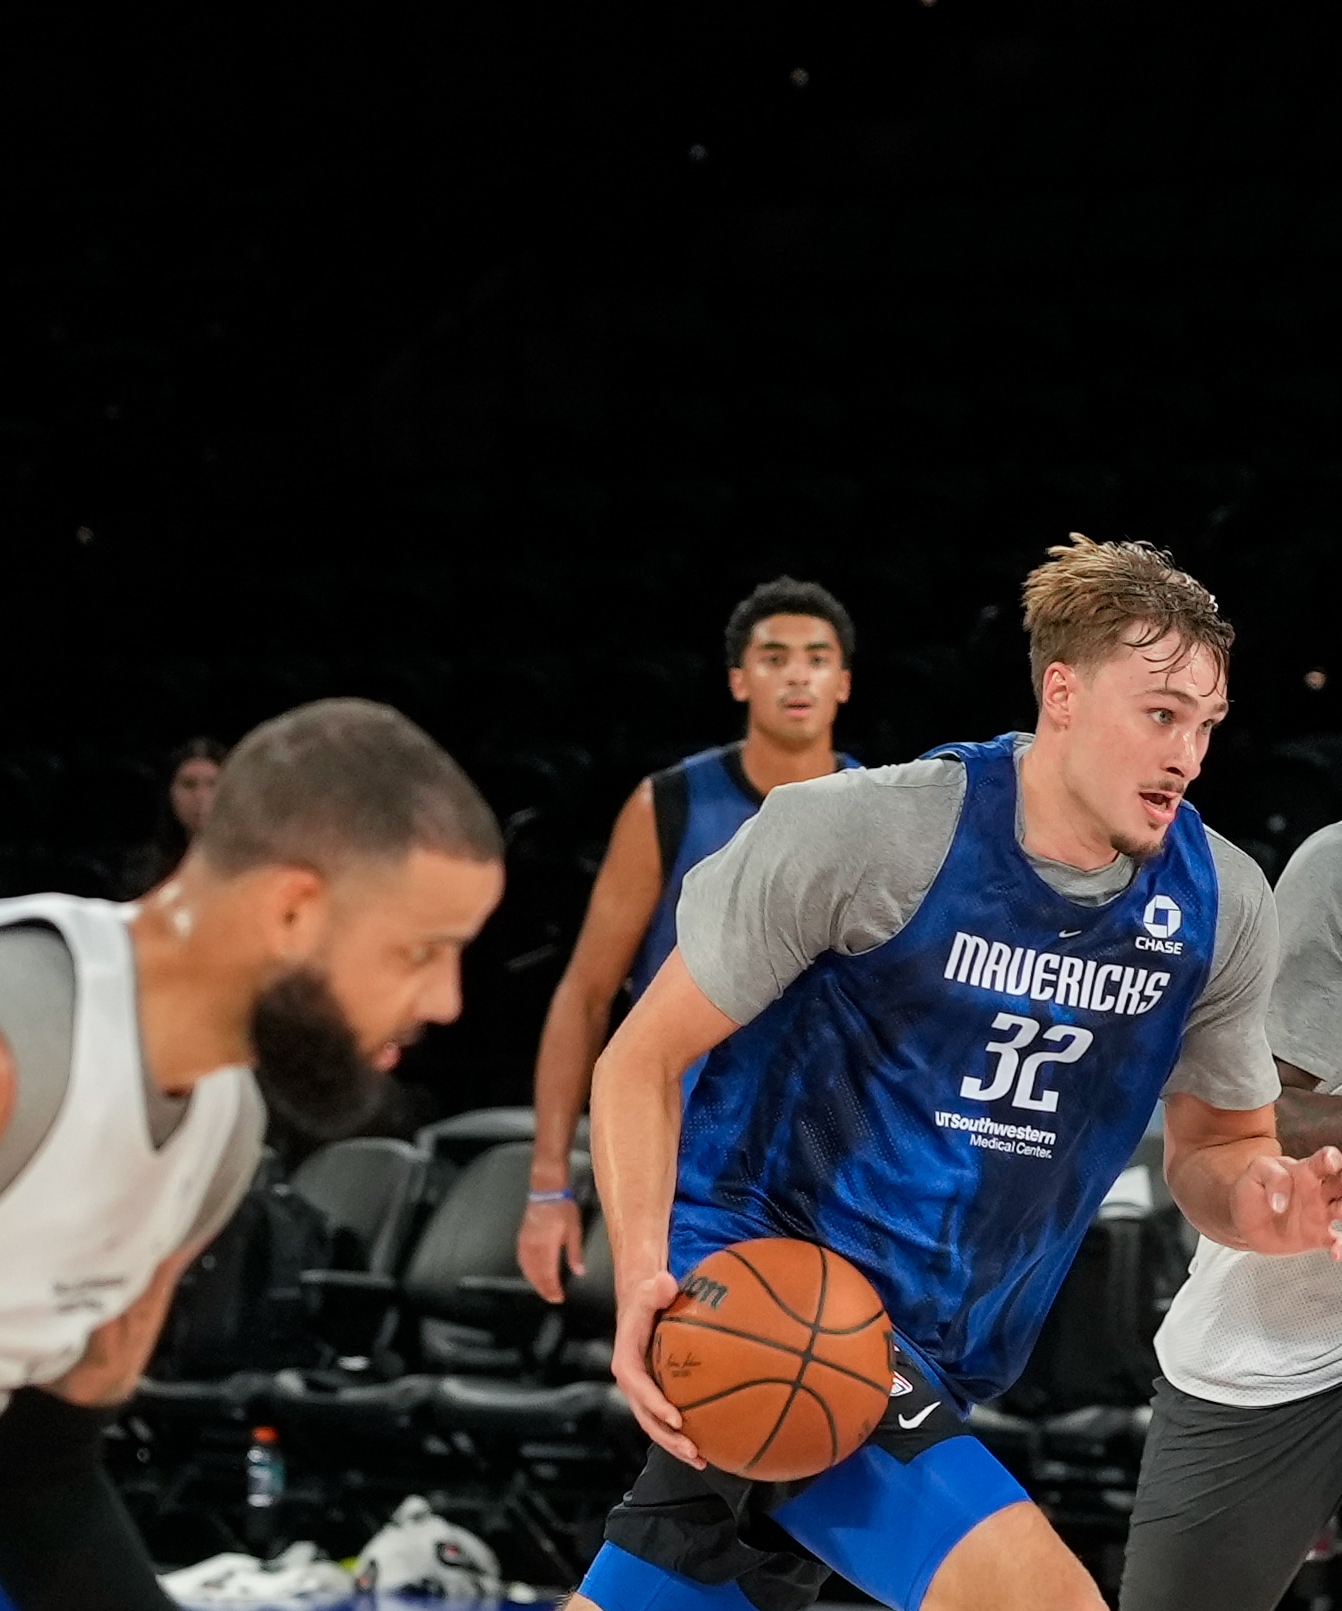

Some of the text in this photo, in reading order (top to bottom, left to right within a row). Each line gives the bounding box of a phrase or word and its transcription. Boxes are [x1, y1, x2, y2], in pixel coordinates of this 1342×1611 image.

[1135, 936, 1183, 955] CHASE
[944, 931, 1170, 1015] MAVERICKS
[959, 1012, 1094, 1112] 32
[969, 1134, 1015, 1153] Medical
